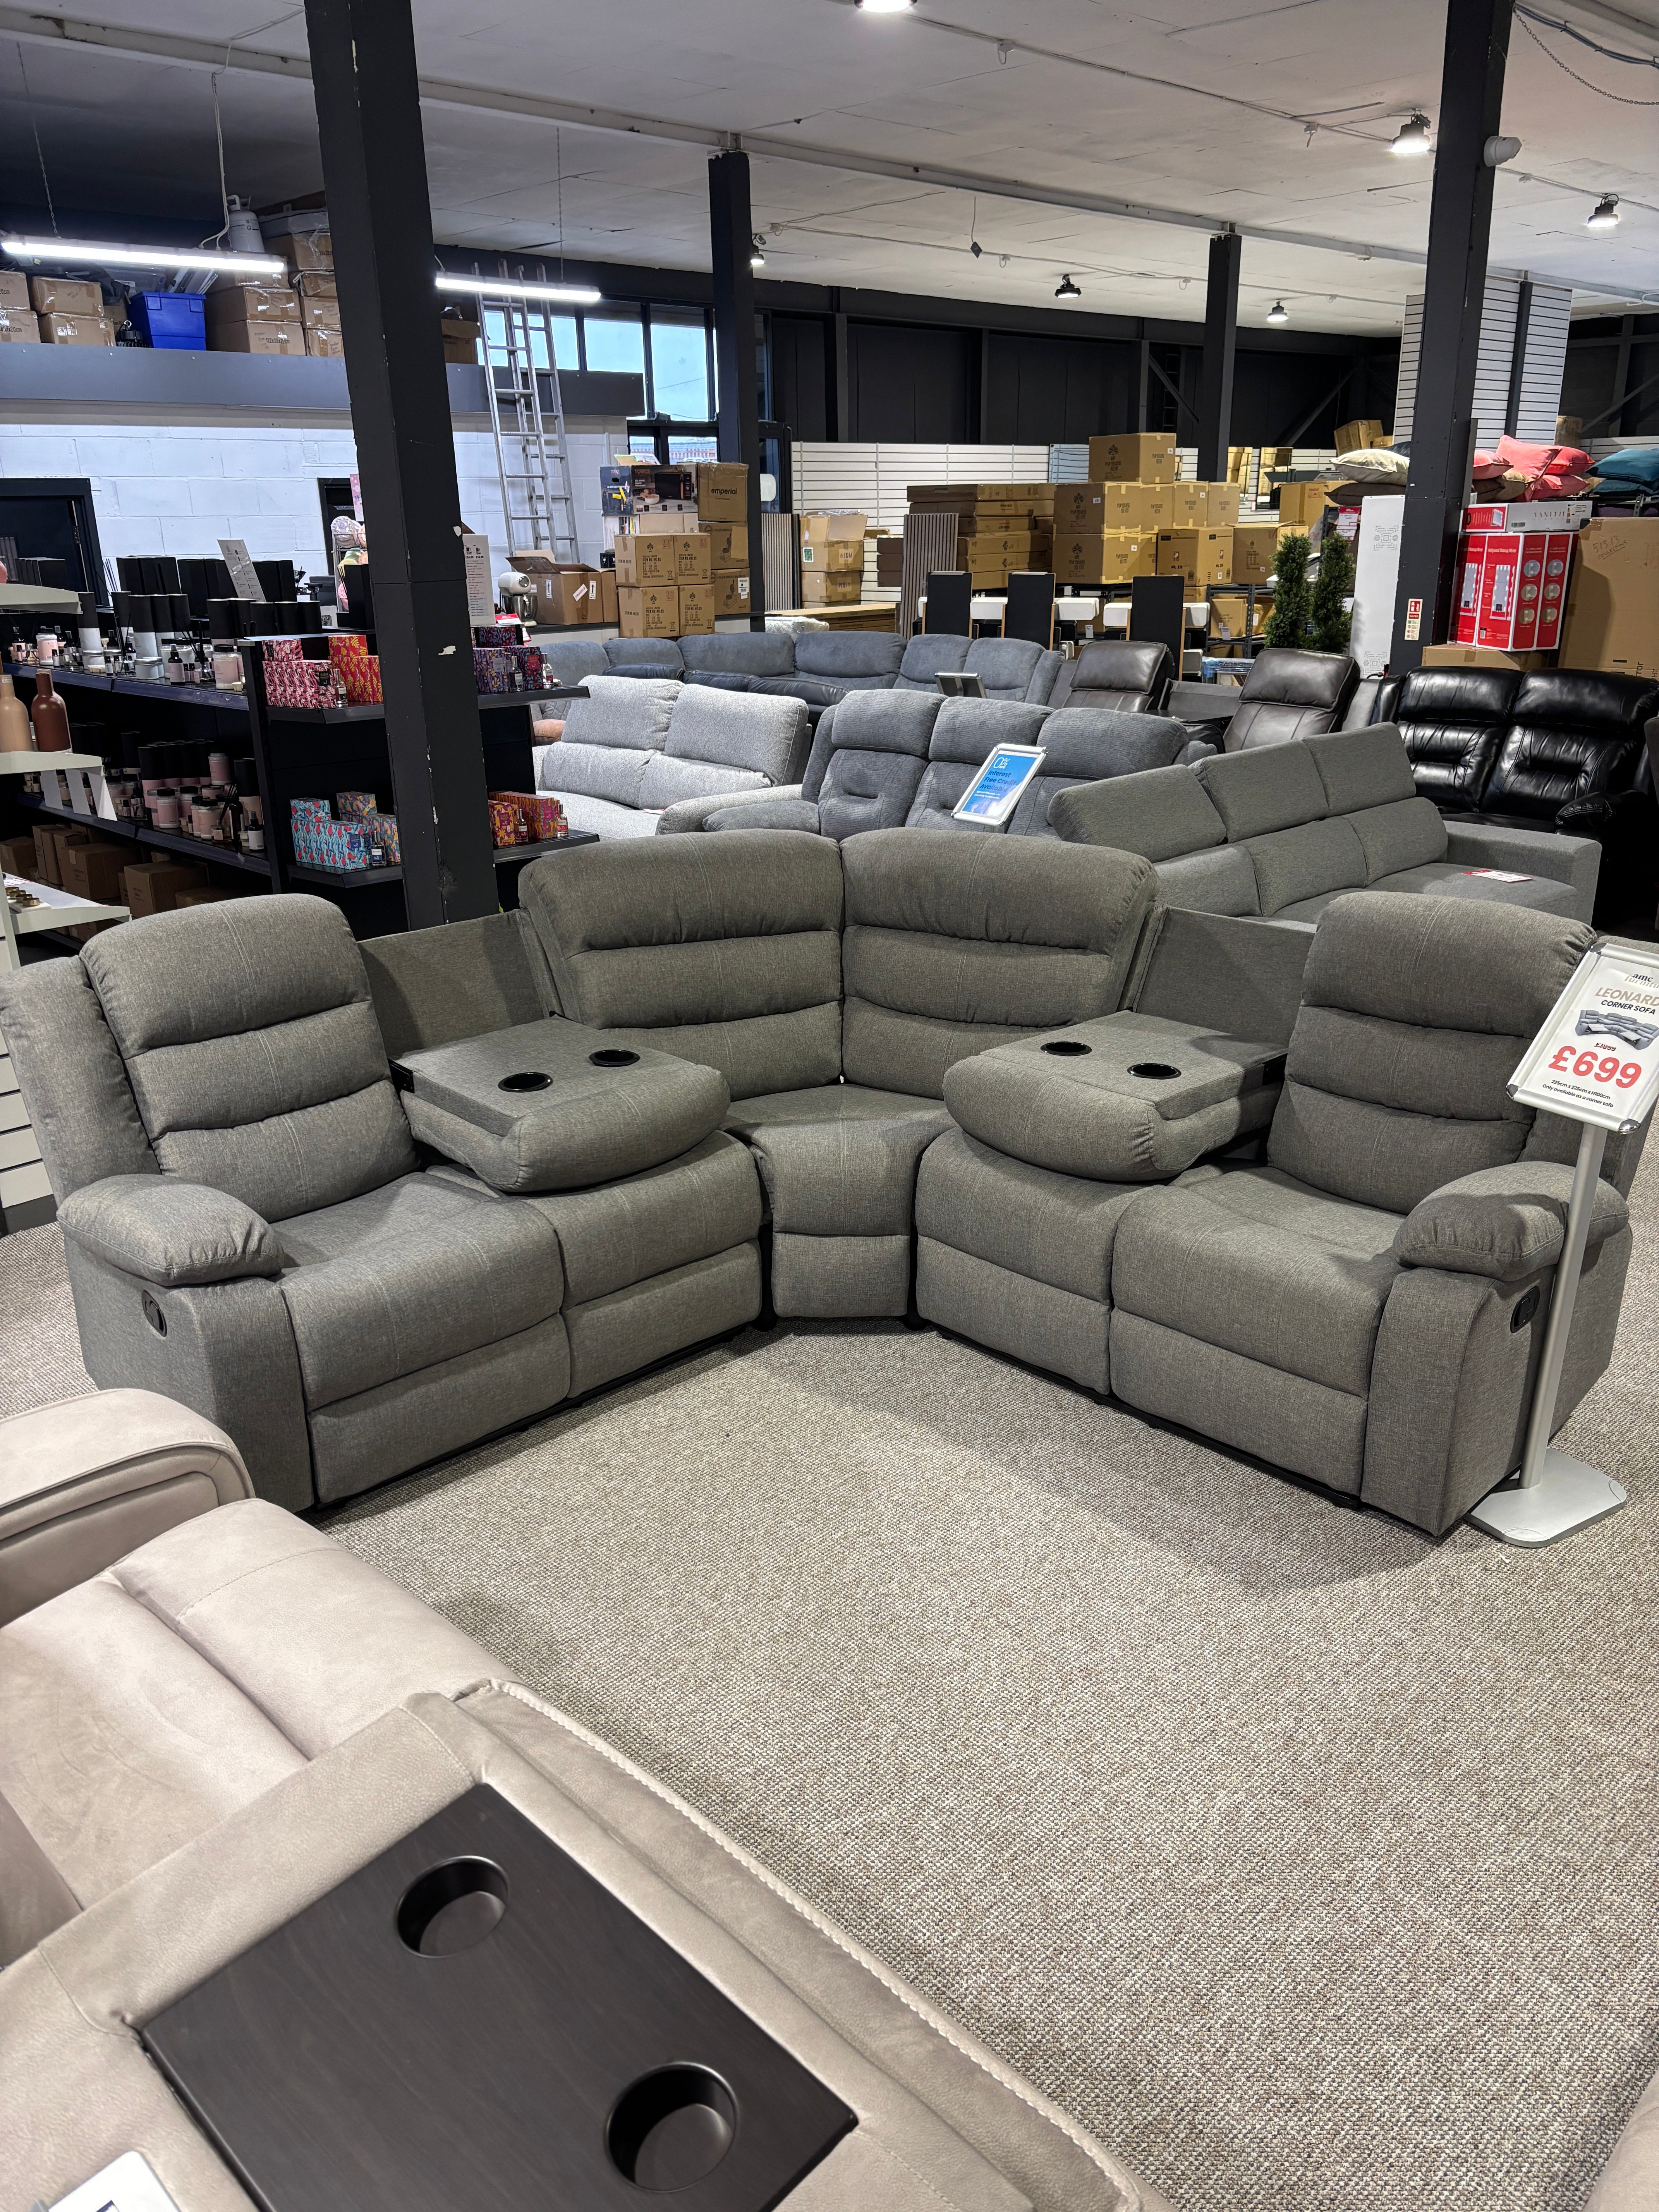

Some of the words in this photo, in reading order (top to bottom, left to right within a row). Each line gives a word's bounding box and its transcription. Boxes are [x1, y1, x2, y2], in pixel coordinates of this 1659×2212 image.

[993, 757, 1011, 768] 0%
[1601, 1000, 1633, 1010] CORNER
[1634, 1005, 1656, 1015] SOFA
[1548, 1046, 1642, 1089] £699
[1554, 1088, 1575, 1096] available
